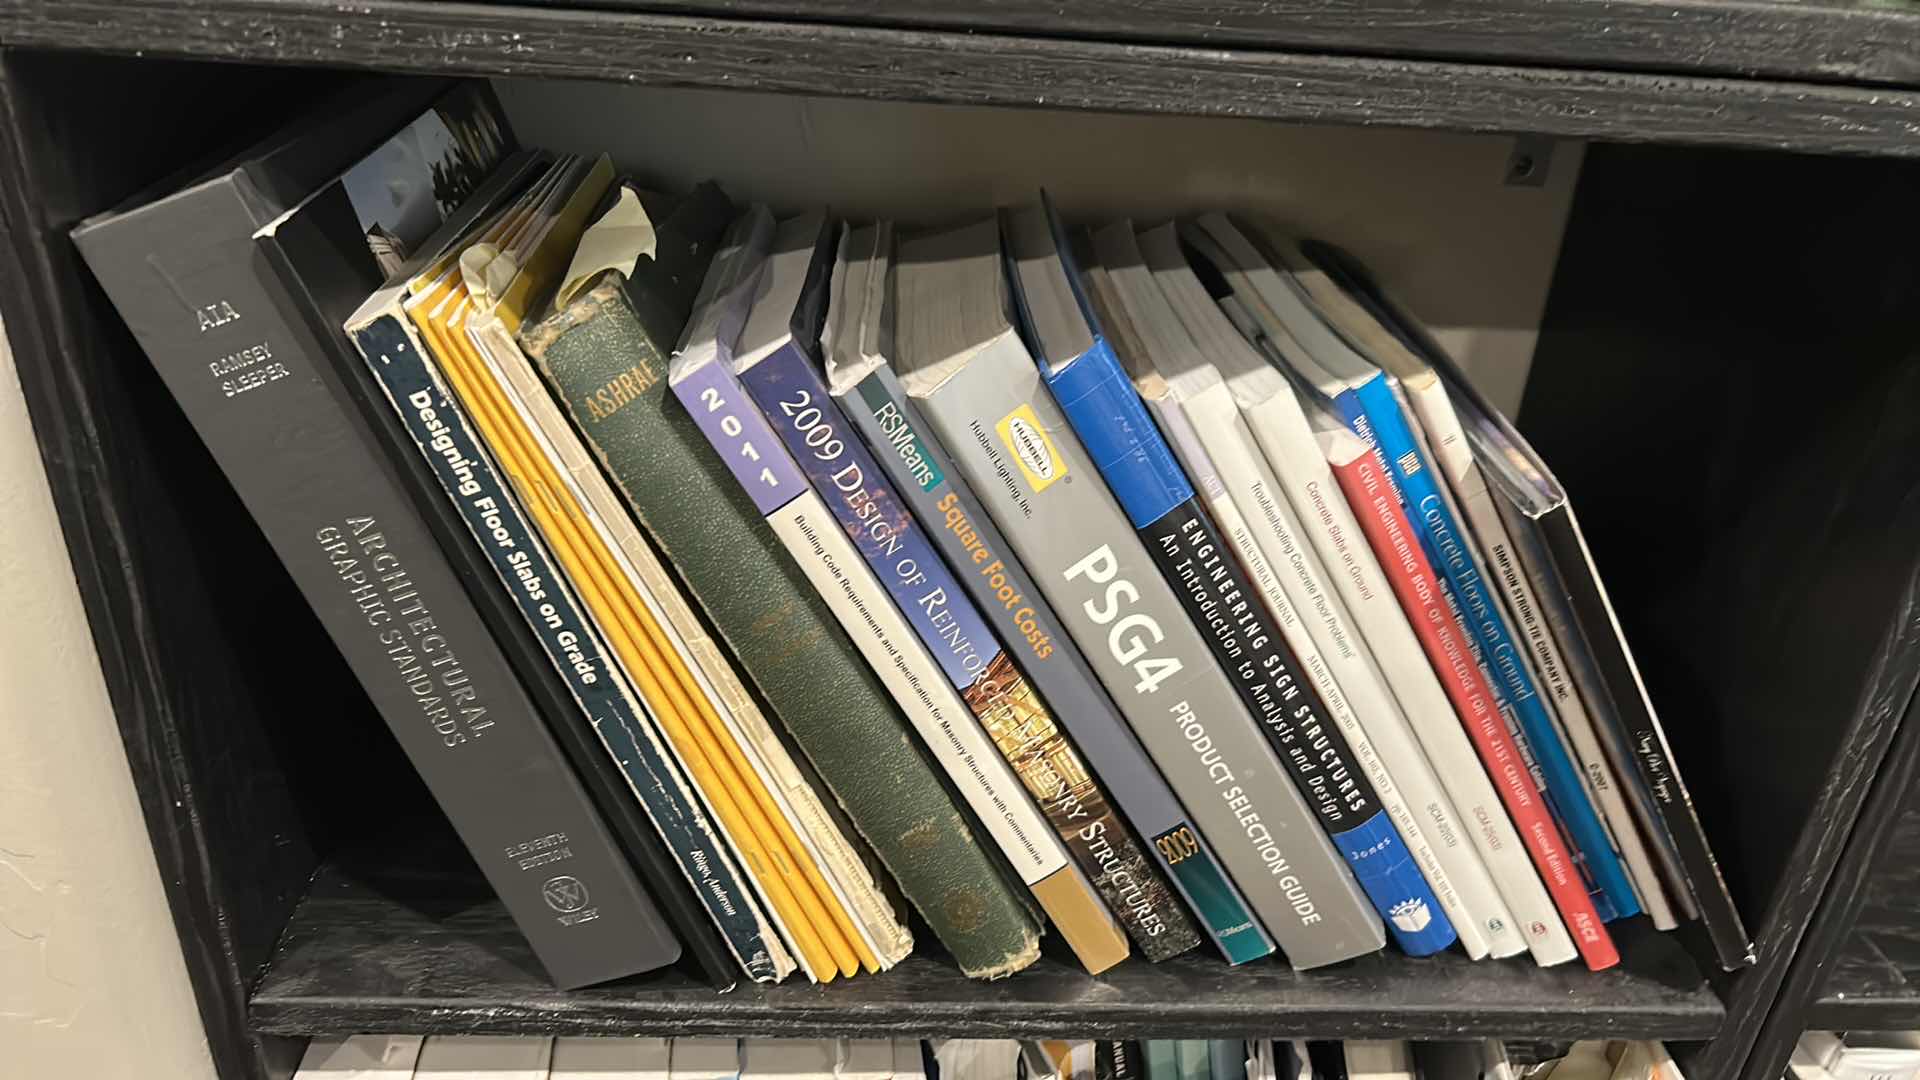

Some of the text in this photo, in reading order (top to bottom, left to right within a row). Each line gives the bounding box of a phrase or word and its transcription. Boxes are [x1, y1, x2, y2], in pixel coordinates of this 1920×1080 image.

[197, 300, 241, 333] AIA
[209, 341, 272, 377] RAMSEY
[222, 363, 290, 397] SLEEPER
[585, 359, 656, 423] ASHRAE
[699, 386, 778, 490] 2011
[872, 401, 937, 486] RSMeans
[968, 420, 1033, 519] Hubbell Lighting, Inc.
[1011, 422, 1049, 474] HUBBELL
[407, 388, 598, 685] Designing Floor Slabs on Grade
[934, 492, 1056, 659] Square Foot Costs
[1234, 527, 1295, 628] STRUCTURAL JOURNAL
[1304, 480, 1374, 601] Concrete Slabs on Ground
[1418, 492, 1468, 568] Concrete
[1456, 568, 1492, 618] Floors
[1480, 619, 1501, 643] on
[1492, 640, 1538, 702] Ground
[316, 524, 466, 750] GRAPHIC STANDARDS
[346, 512, 499, 739] ARCHITECTURAL
[1060, 543, 1187, 696] PSG4
[1158, 532, 1344, 822] An Introduction to Analysis and Design
[1180, 518, 1366, 812] ENGINEERING SIGN STRUCTURES
[1356, 462, 1532, 807] CIVIL ENGINEERING BODY OF KNOWLEDGE FOR THE 21ST CENTURY
[1491, 543, 1570, 700] SIMPSON STRONG-TIE COMPANY INC.
[792, 514, 1045, 867] Building Code Requirements and Specification for Masonry Structures with Commentaries
[1168, 700, 1322, 928] PRODUCT SELECTION GUIDE
[1530, 821, 1568, 886] Second Edition
[702, 876, 736, 918] Anderson
[1572, 910, 1600, 944] ASCE
